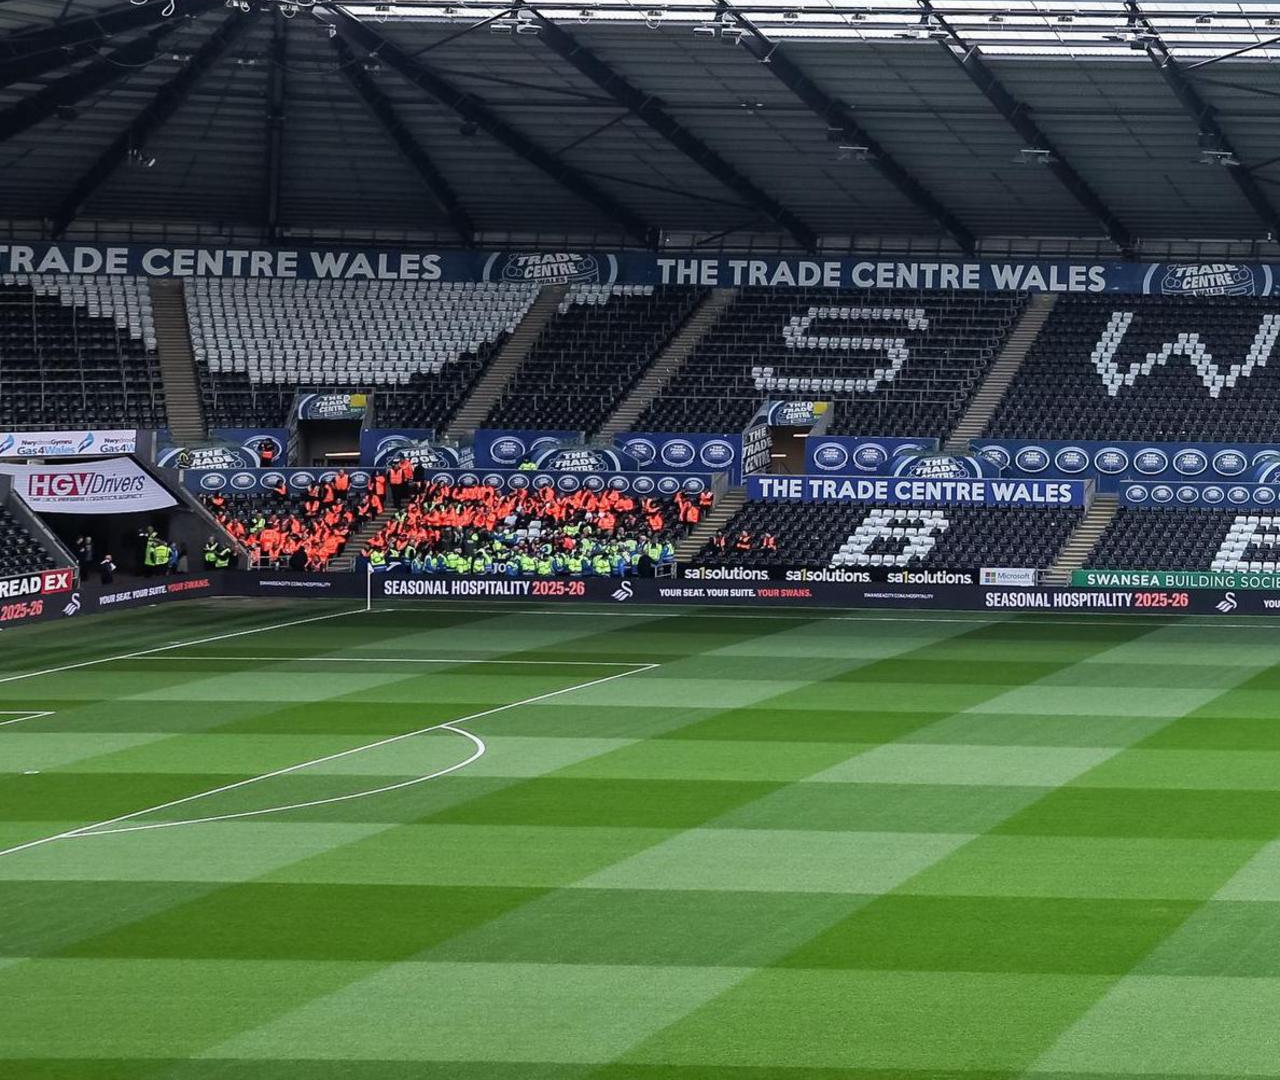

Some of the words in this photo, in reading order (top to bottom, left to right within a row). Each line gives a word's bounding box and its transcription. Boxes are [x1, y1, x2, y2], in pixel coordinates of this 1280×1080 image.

[142, 249, 297, 276] CENTRE
[310, 252, 442, 279] WALES
[517, 253, 583, 266] TRADE
[524, 263, 579, 278] CENTRE
[657, 259, 718, 284] THE
[728, 260, 840, 286] TRADE
[852, 261, 979, 288] CENTRE
[990, 264, 1105, 291] WALES
[1175, 264, 1238, 277] TRADE
[1182, 273, 1234, 290] CENTRE
[759, 479, 802, 498] THE
[809, 479, 887, 499] TRADE
[895, 481, 985, 501] CENTRE
[992, 483, 1072, 503] WALES
[998, 572, 1030, 580] Microsoft
[1087, 574, 1159, 586] SWANSEA
[1165, 575, 1235, 587] BUILDING
[384, 581, 448, 595] SEASONAL
[452, 581, 530, 595] HOSPITALITY
[532, 581, 585, 595] 2025-26
[659, 589, 681, 597] YOUR
[683, 588, 705, 597] SEAT.
[706, 588, 728, 597] YOUR
[730, 588, 756, 597] SUITE.
[757, 588, 779, 597] YOUR
[780, 588, 812, 597] SWANS.
[986, 593, 1050, 607] SEASONAL
[1053, 593, 1132, 607] HOSPITALITY
[1135, 593, 1188, 607] 2025-26
